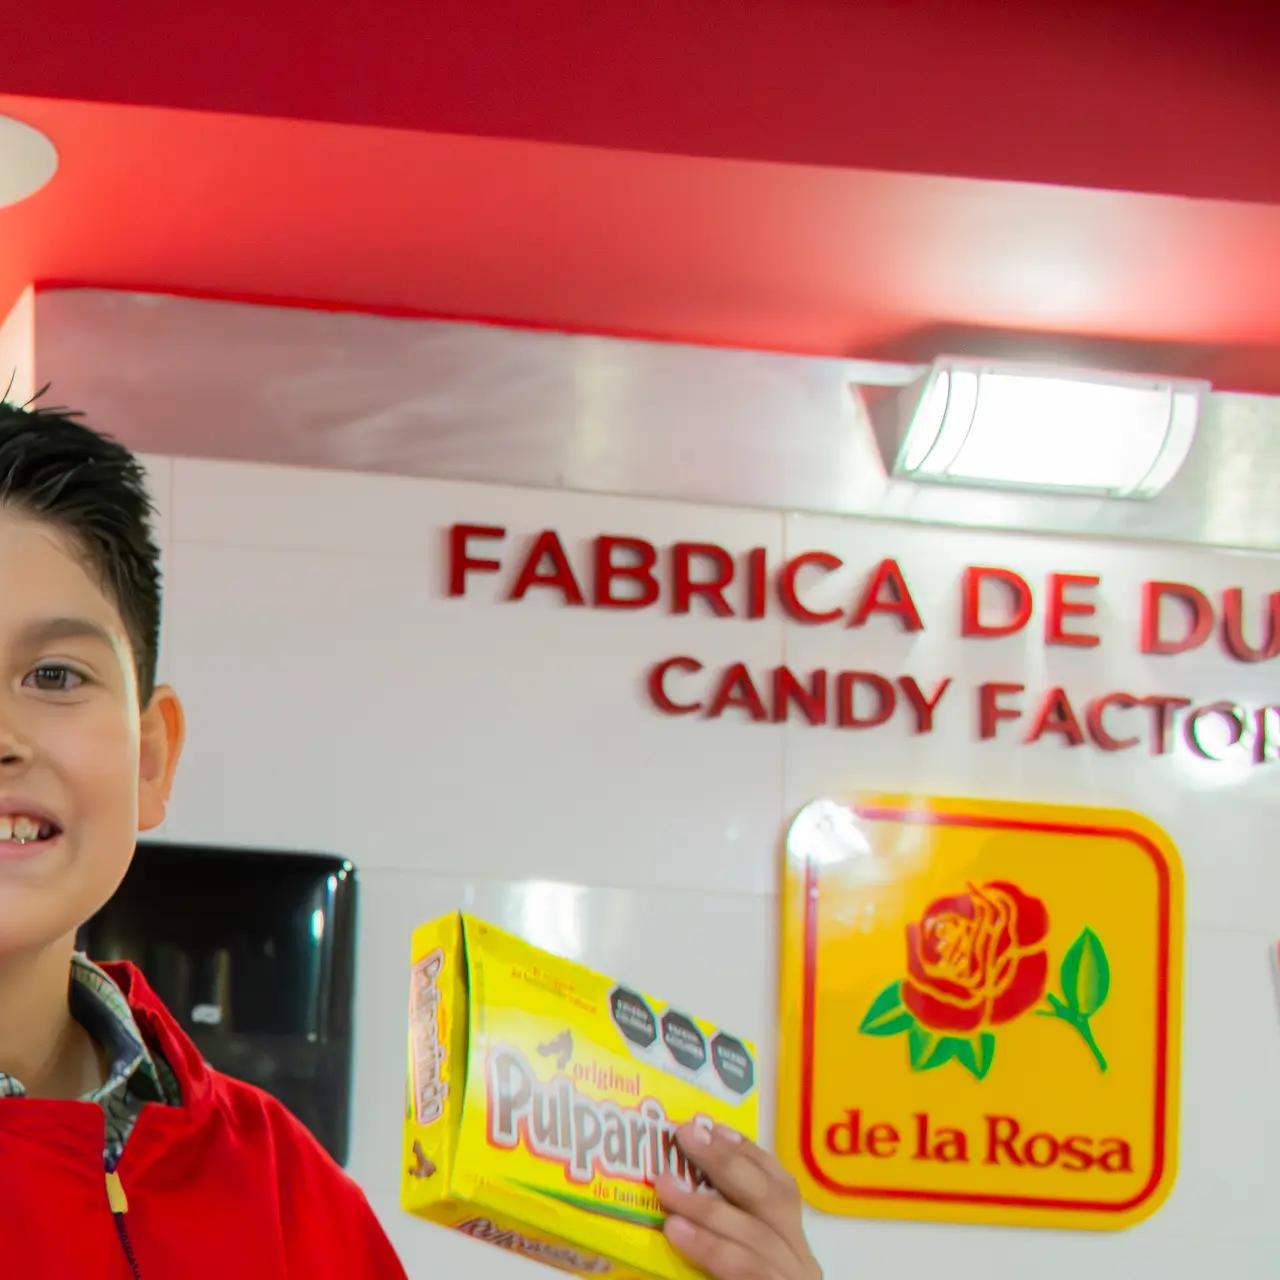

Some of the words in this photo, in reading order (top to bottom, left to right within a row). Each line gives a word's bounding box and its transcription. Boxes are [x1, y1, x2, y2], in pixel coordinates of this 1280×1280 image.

[445, 522, 926, 633] FABRICA
[960, 565, 1101, 648] DE
[1140, 578, 1280, 664] DU
[646, 656, 952, 736] CANDY
[572, 1060, 641, 1096] original
[492, 1050, 704, 1190] Pulparin
[824, 1107, 902, 1158] de
[912, 1110, 970, 1164] la
[982, 1113, 1134, 1174] Rosa
